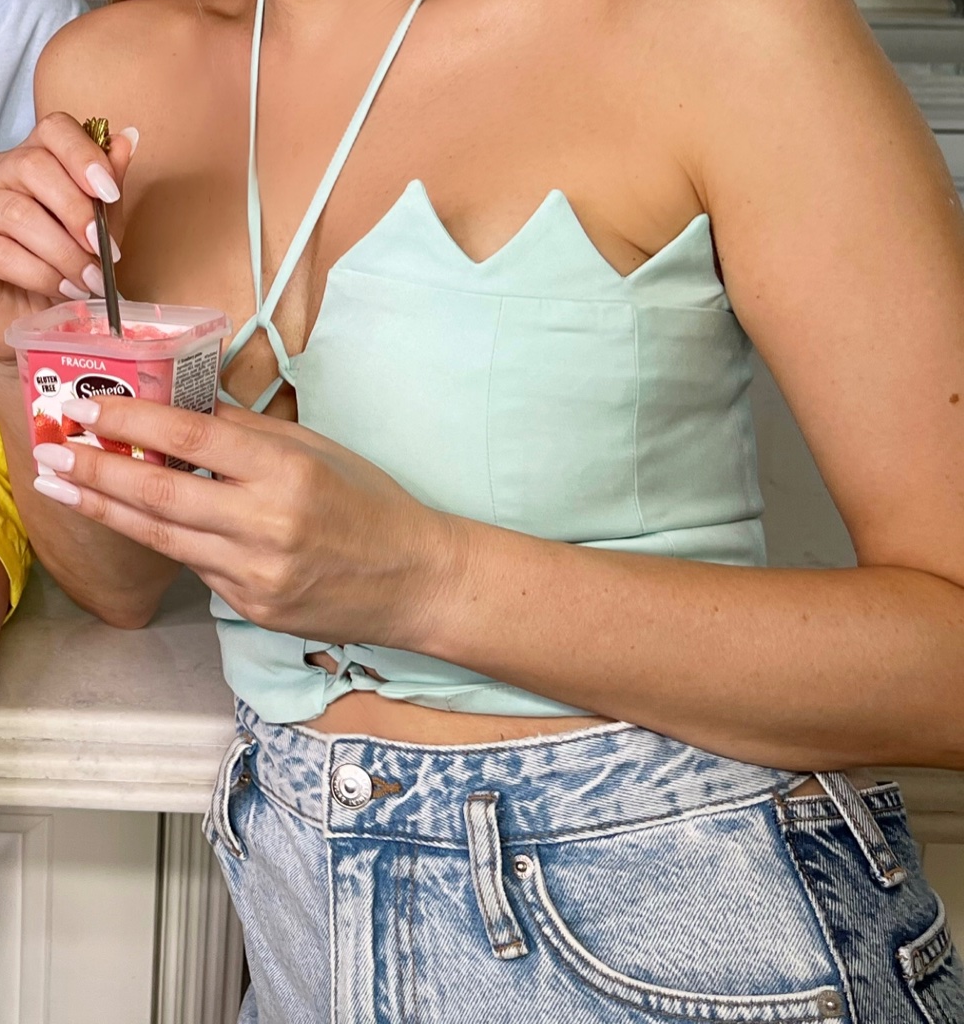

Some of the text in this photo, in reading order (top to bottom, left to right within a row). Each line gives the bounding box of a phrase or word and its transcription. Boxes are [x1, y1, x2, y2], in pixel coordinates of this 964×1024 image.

[61, 356, 106, 371] FRAGOLA
[36, 375, 58, 384] GLUTEN
[41, 384, 56, 393] FREE
